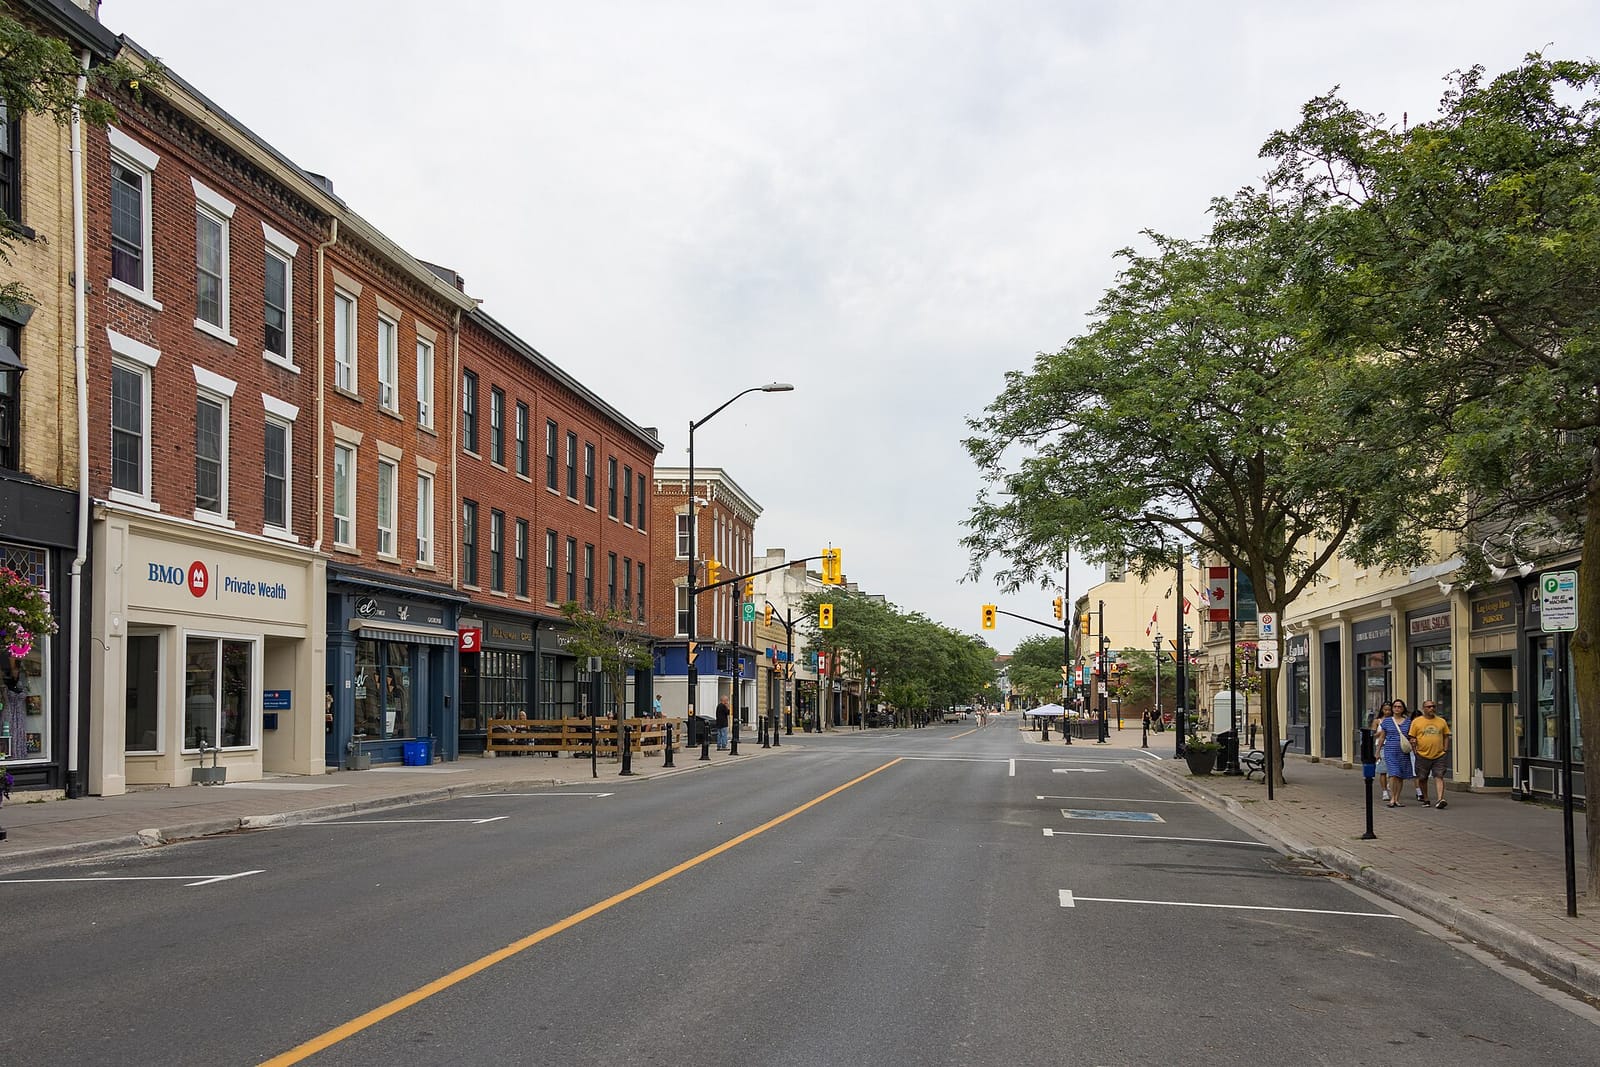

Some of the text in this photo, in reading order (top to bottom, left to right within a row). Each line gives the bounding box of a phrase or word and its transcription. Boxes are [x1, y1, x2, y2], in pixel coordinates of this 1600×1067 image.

[148, 562, 184, 586] BMO
[224, 576, 287, 600] Private Wealth
